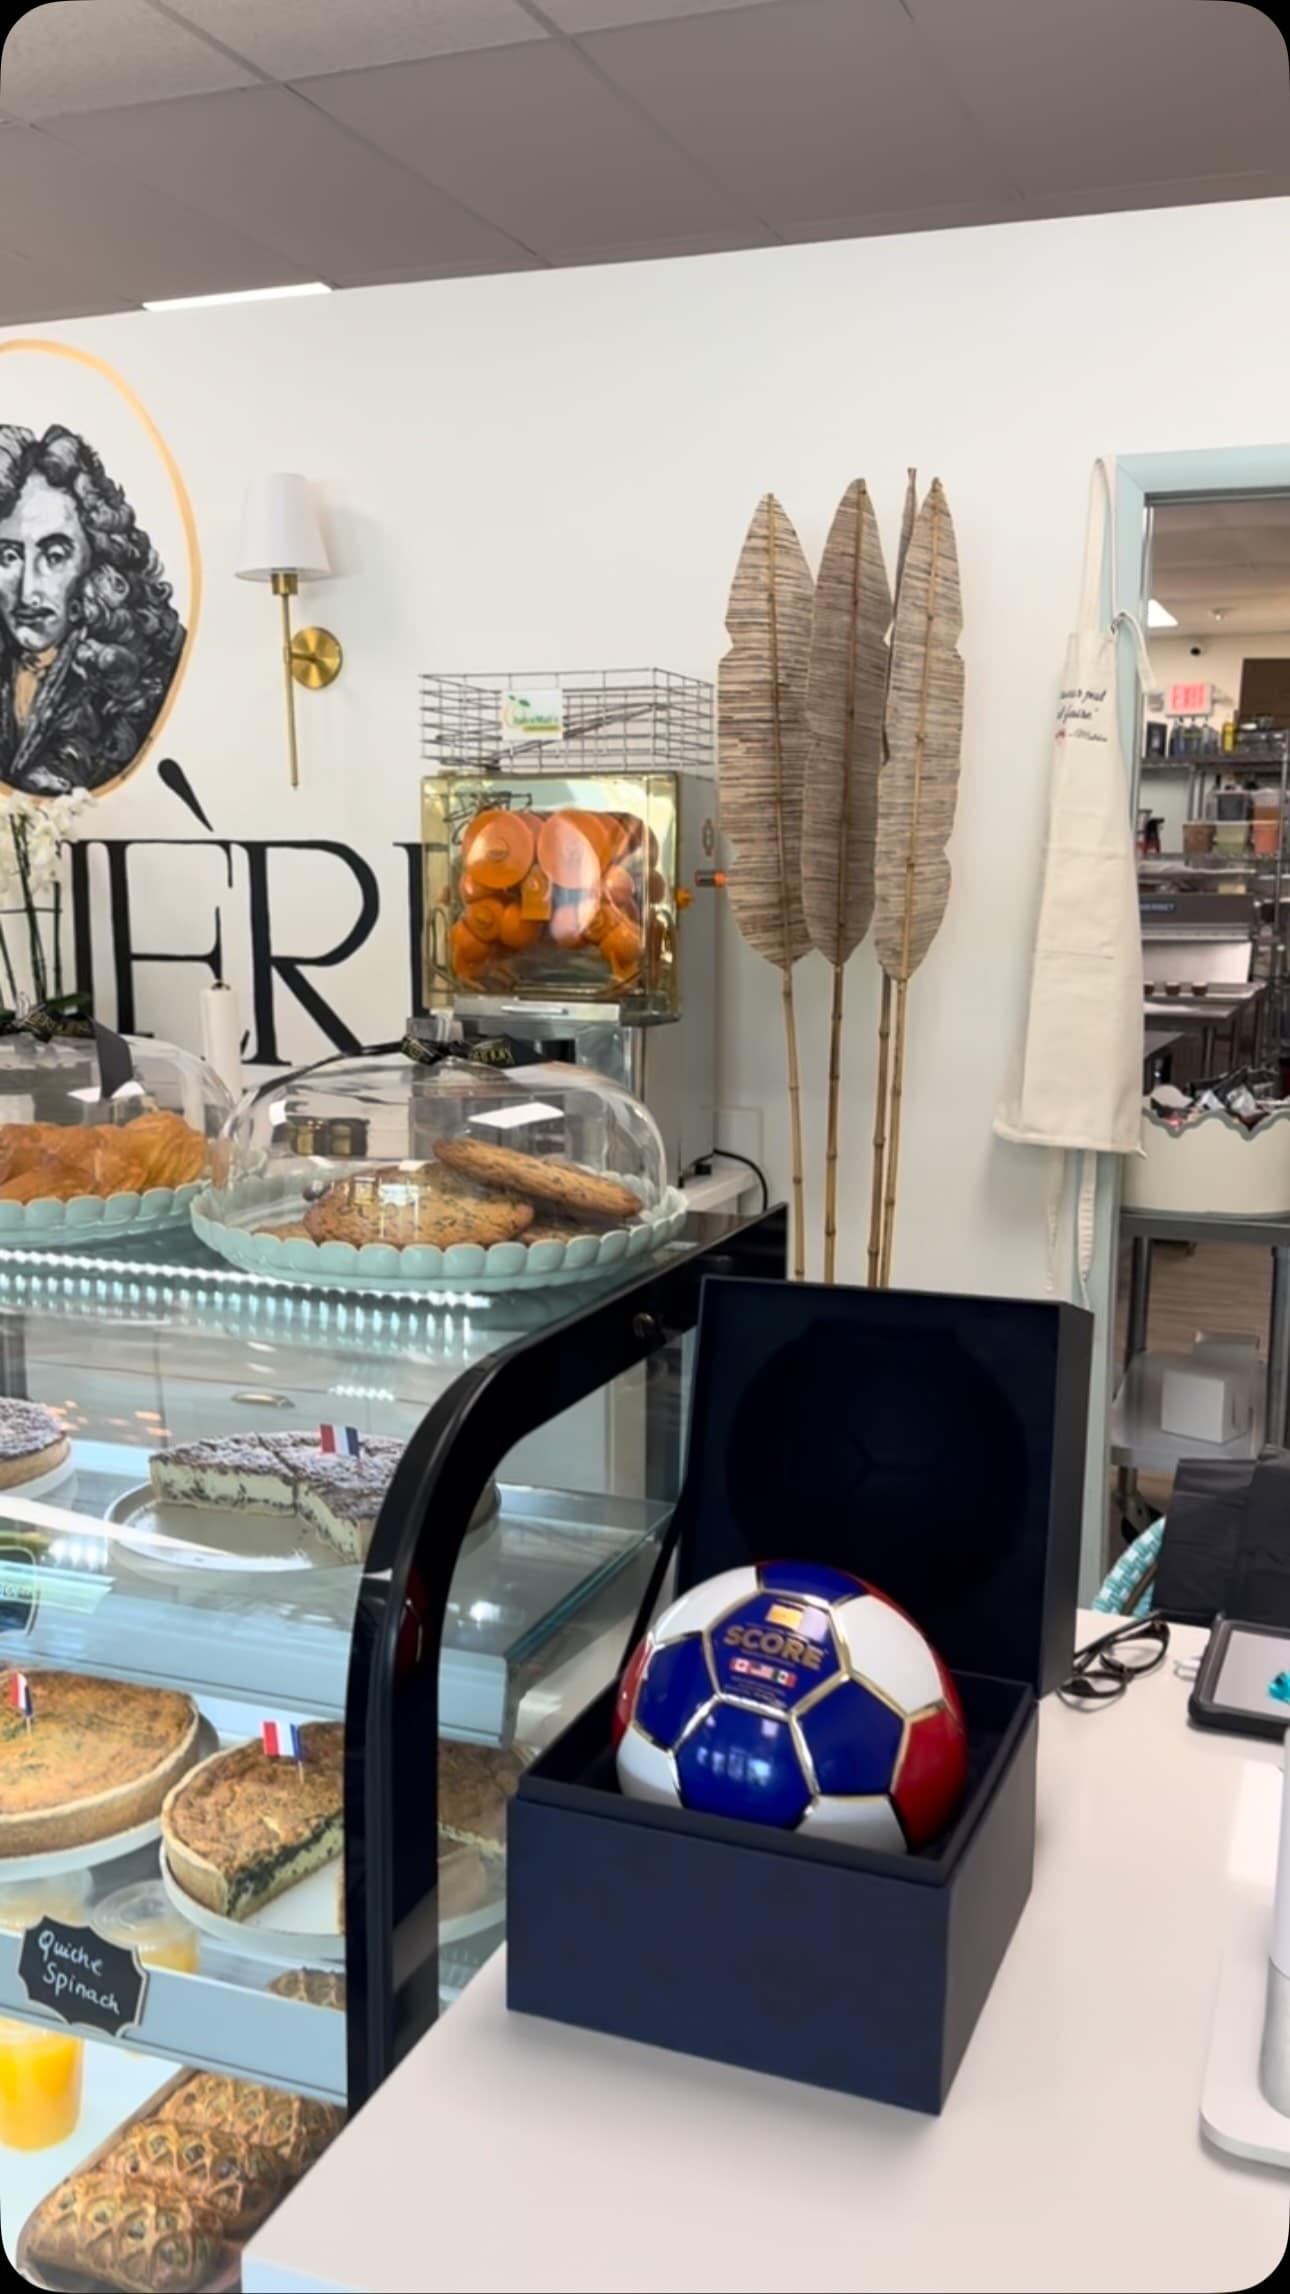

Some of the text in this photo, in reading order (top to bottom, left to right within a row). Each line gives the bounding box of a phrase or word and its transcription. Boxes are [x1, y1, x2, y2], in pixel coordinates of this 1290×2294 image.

[723, 1625, 824, 1671] SCORE
[38, 1929, 103, 1977] Quiche
[42, 1962, 121, 2016] Spinach
